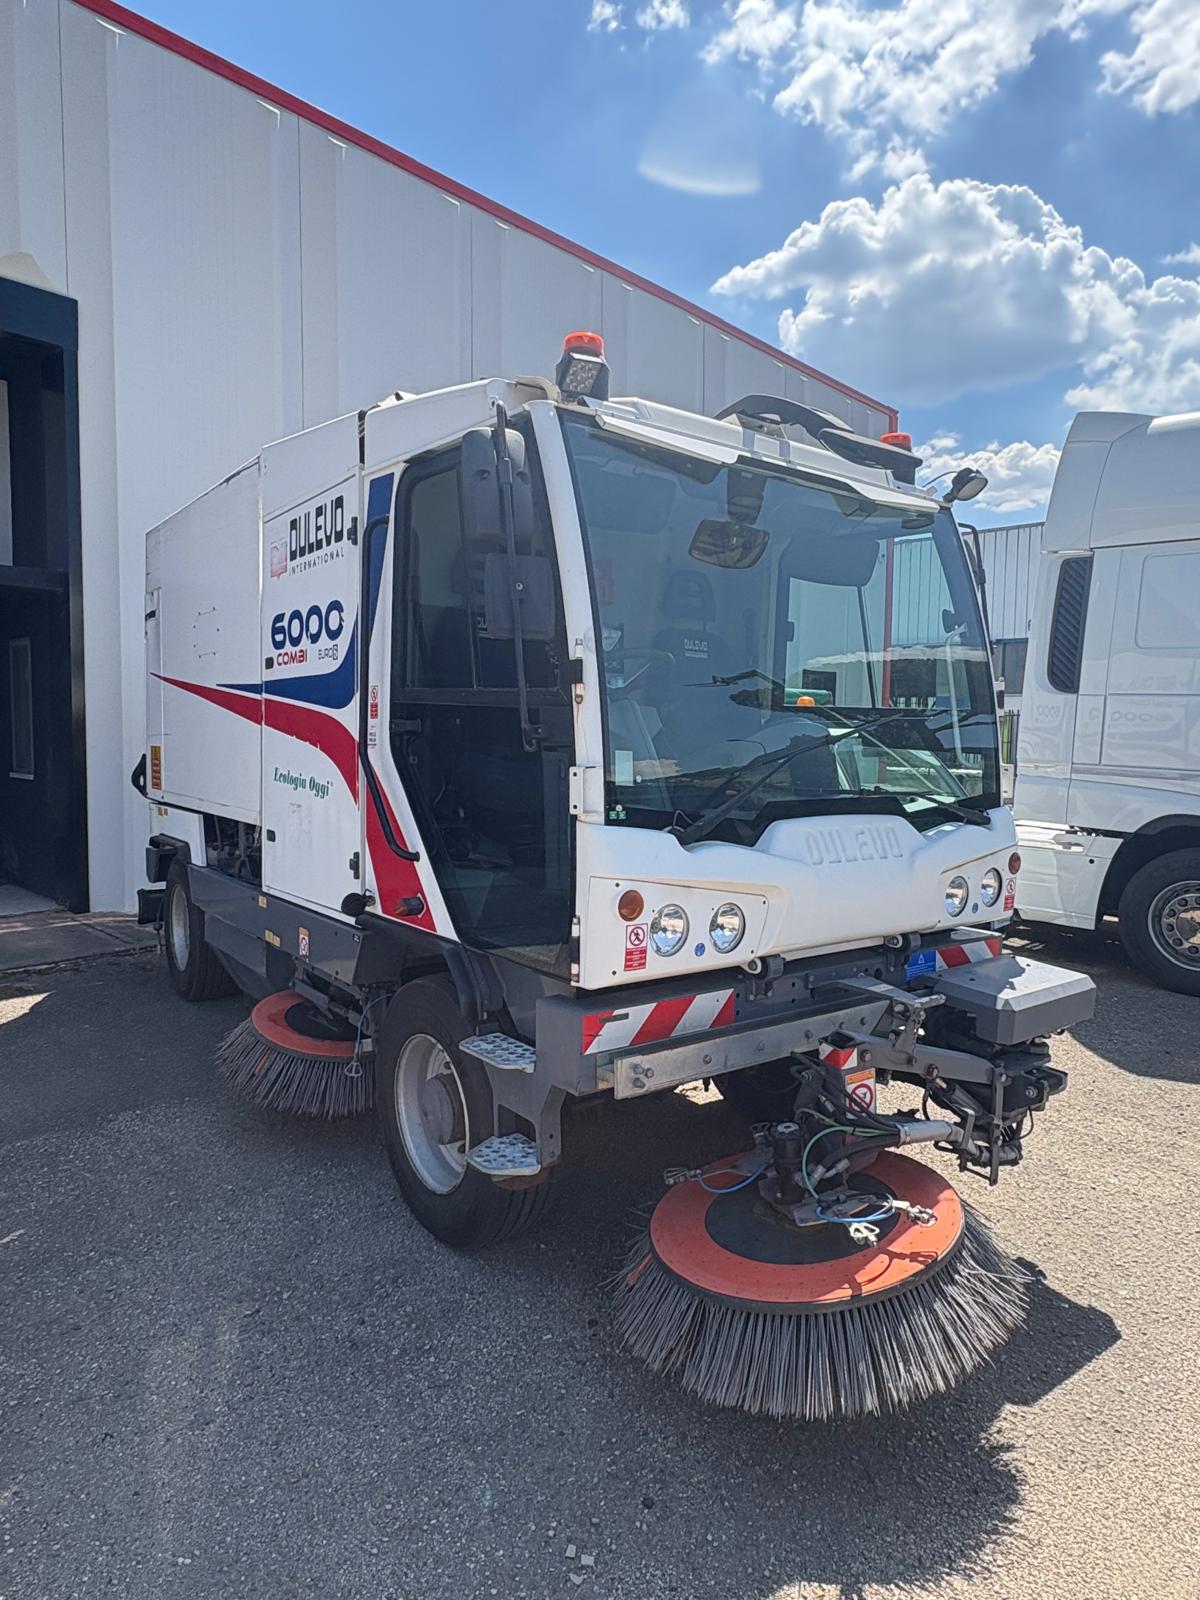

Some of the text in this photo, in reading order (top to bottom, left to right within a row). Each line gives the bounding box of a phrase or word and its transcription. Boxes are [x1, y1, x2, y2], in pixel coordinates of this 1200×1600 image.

[289, 494, 344, 563] DULEVO
[288, 546, 344, 577] INTERNATIONAL
[271, 599, 345, 651] 6000
[276, 648, 308, 667] COMBI
[273, 767, 307, 792] Ecologia
[805, 824, 904, 867] DULEVO
